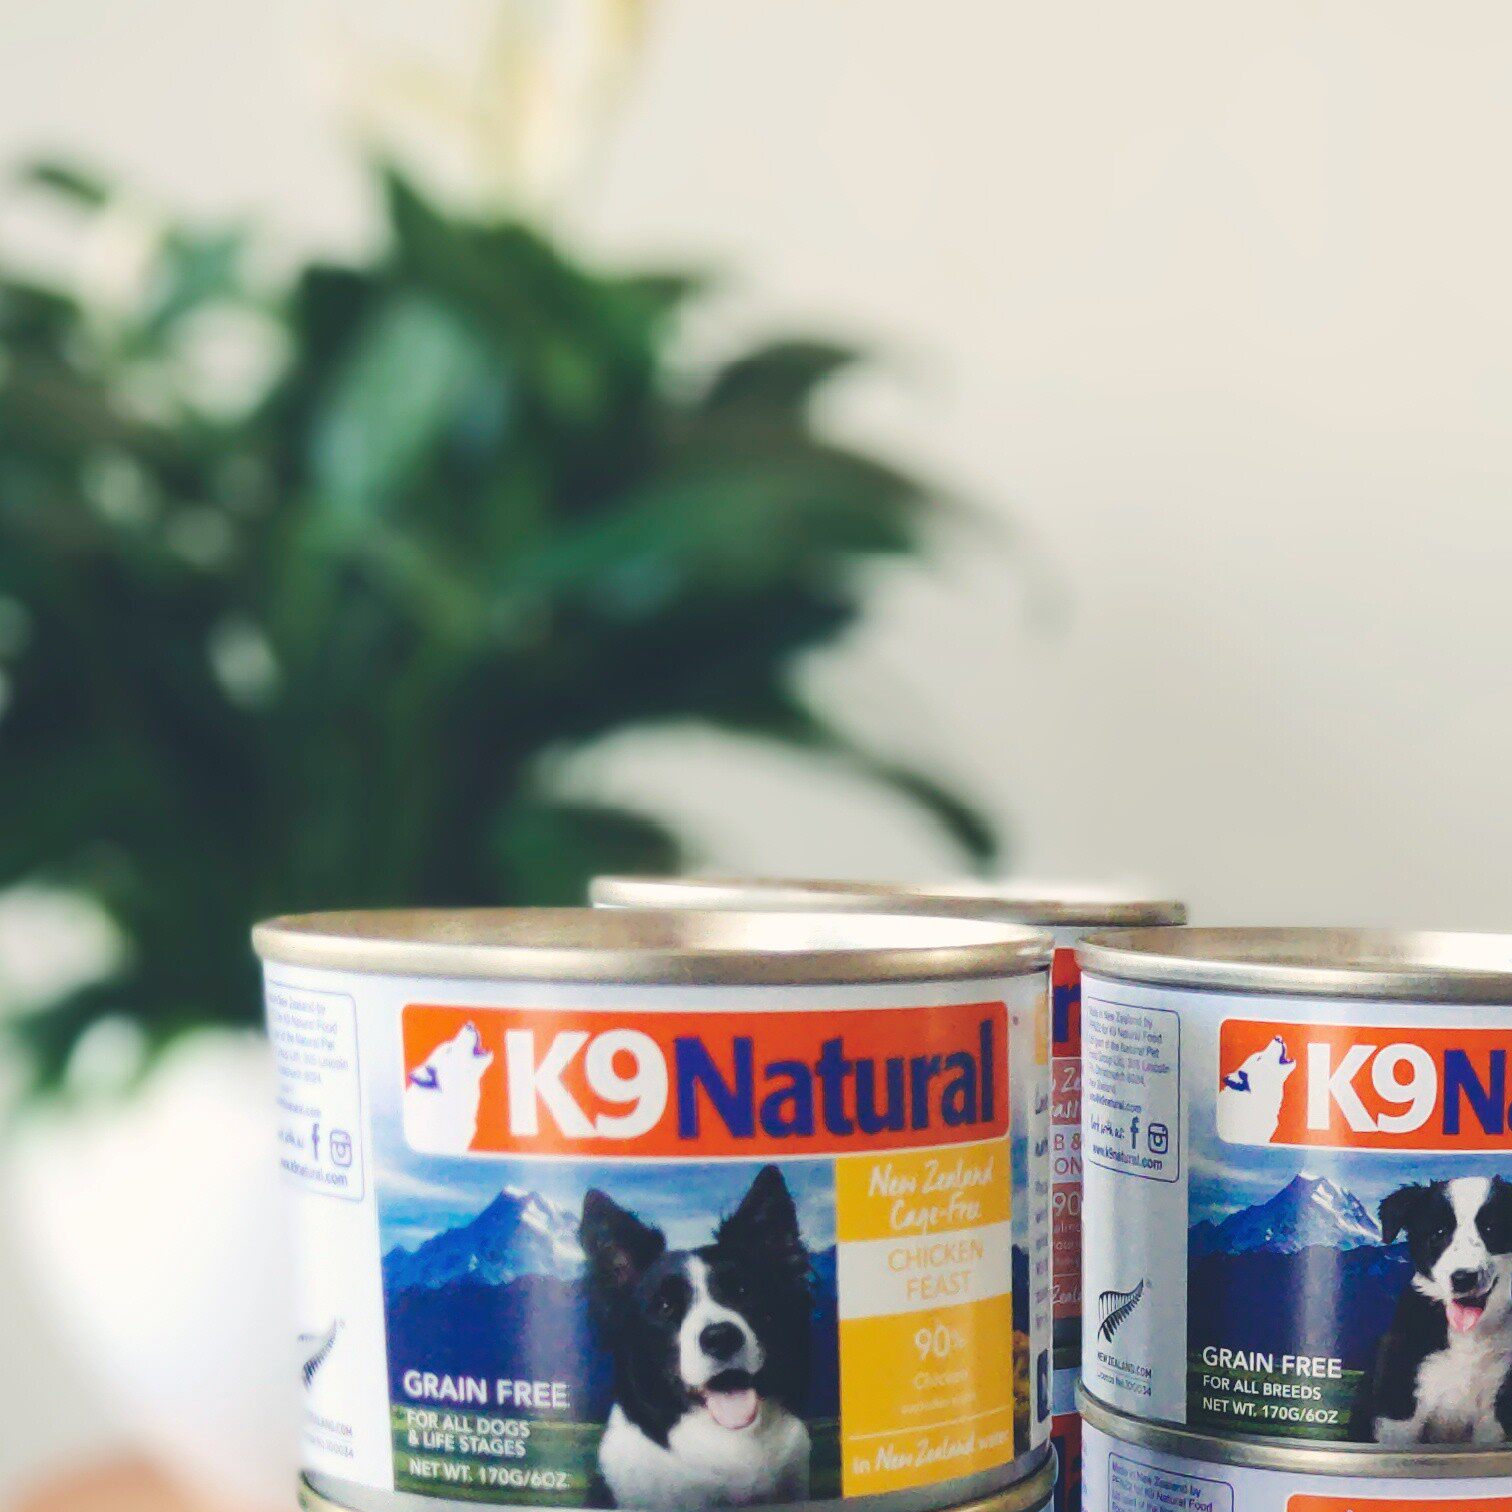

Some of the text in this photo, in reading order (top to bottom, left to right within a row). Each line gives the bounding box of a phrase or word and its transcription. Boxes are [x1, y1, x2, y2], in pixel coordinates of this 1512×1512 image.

[868, 1163, 917, 1197] New
[887, 1240, 984, 1272] CHICKEN
[906, 1270, 972, 1302] FEAST
[1202, 1345, 1342, 1379] GRAIN FREE
[402, 1368, 570, 1408] GRAIN FREE
[1203, 1374, 1322, 1401] FOR ALL BREEDS
[406, 1410, 531, 1438] FOR ALL DOGS
[1203, 1397, 1339, 1424] NET WT. 170G/6OZ
[407, 1428, 527, 1458] & LIFE STAGES
[409, 1459, 442, 1478] NET
